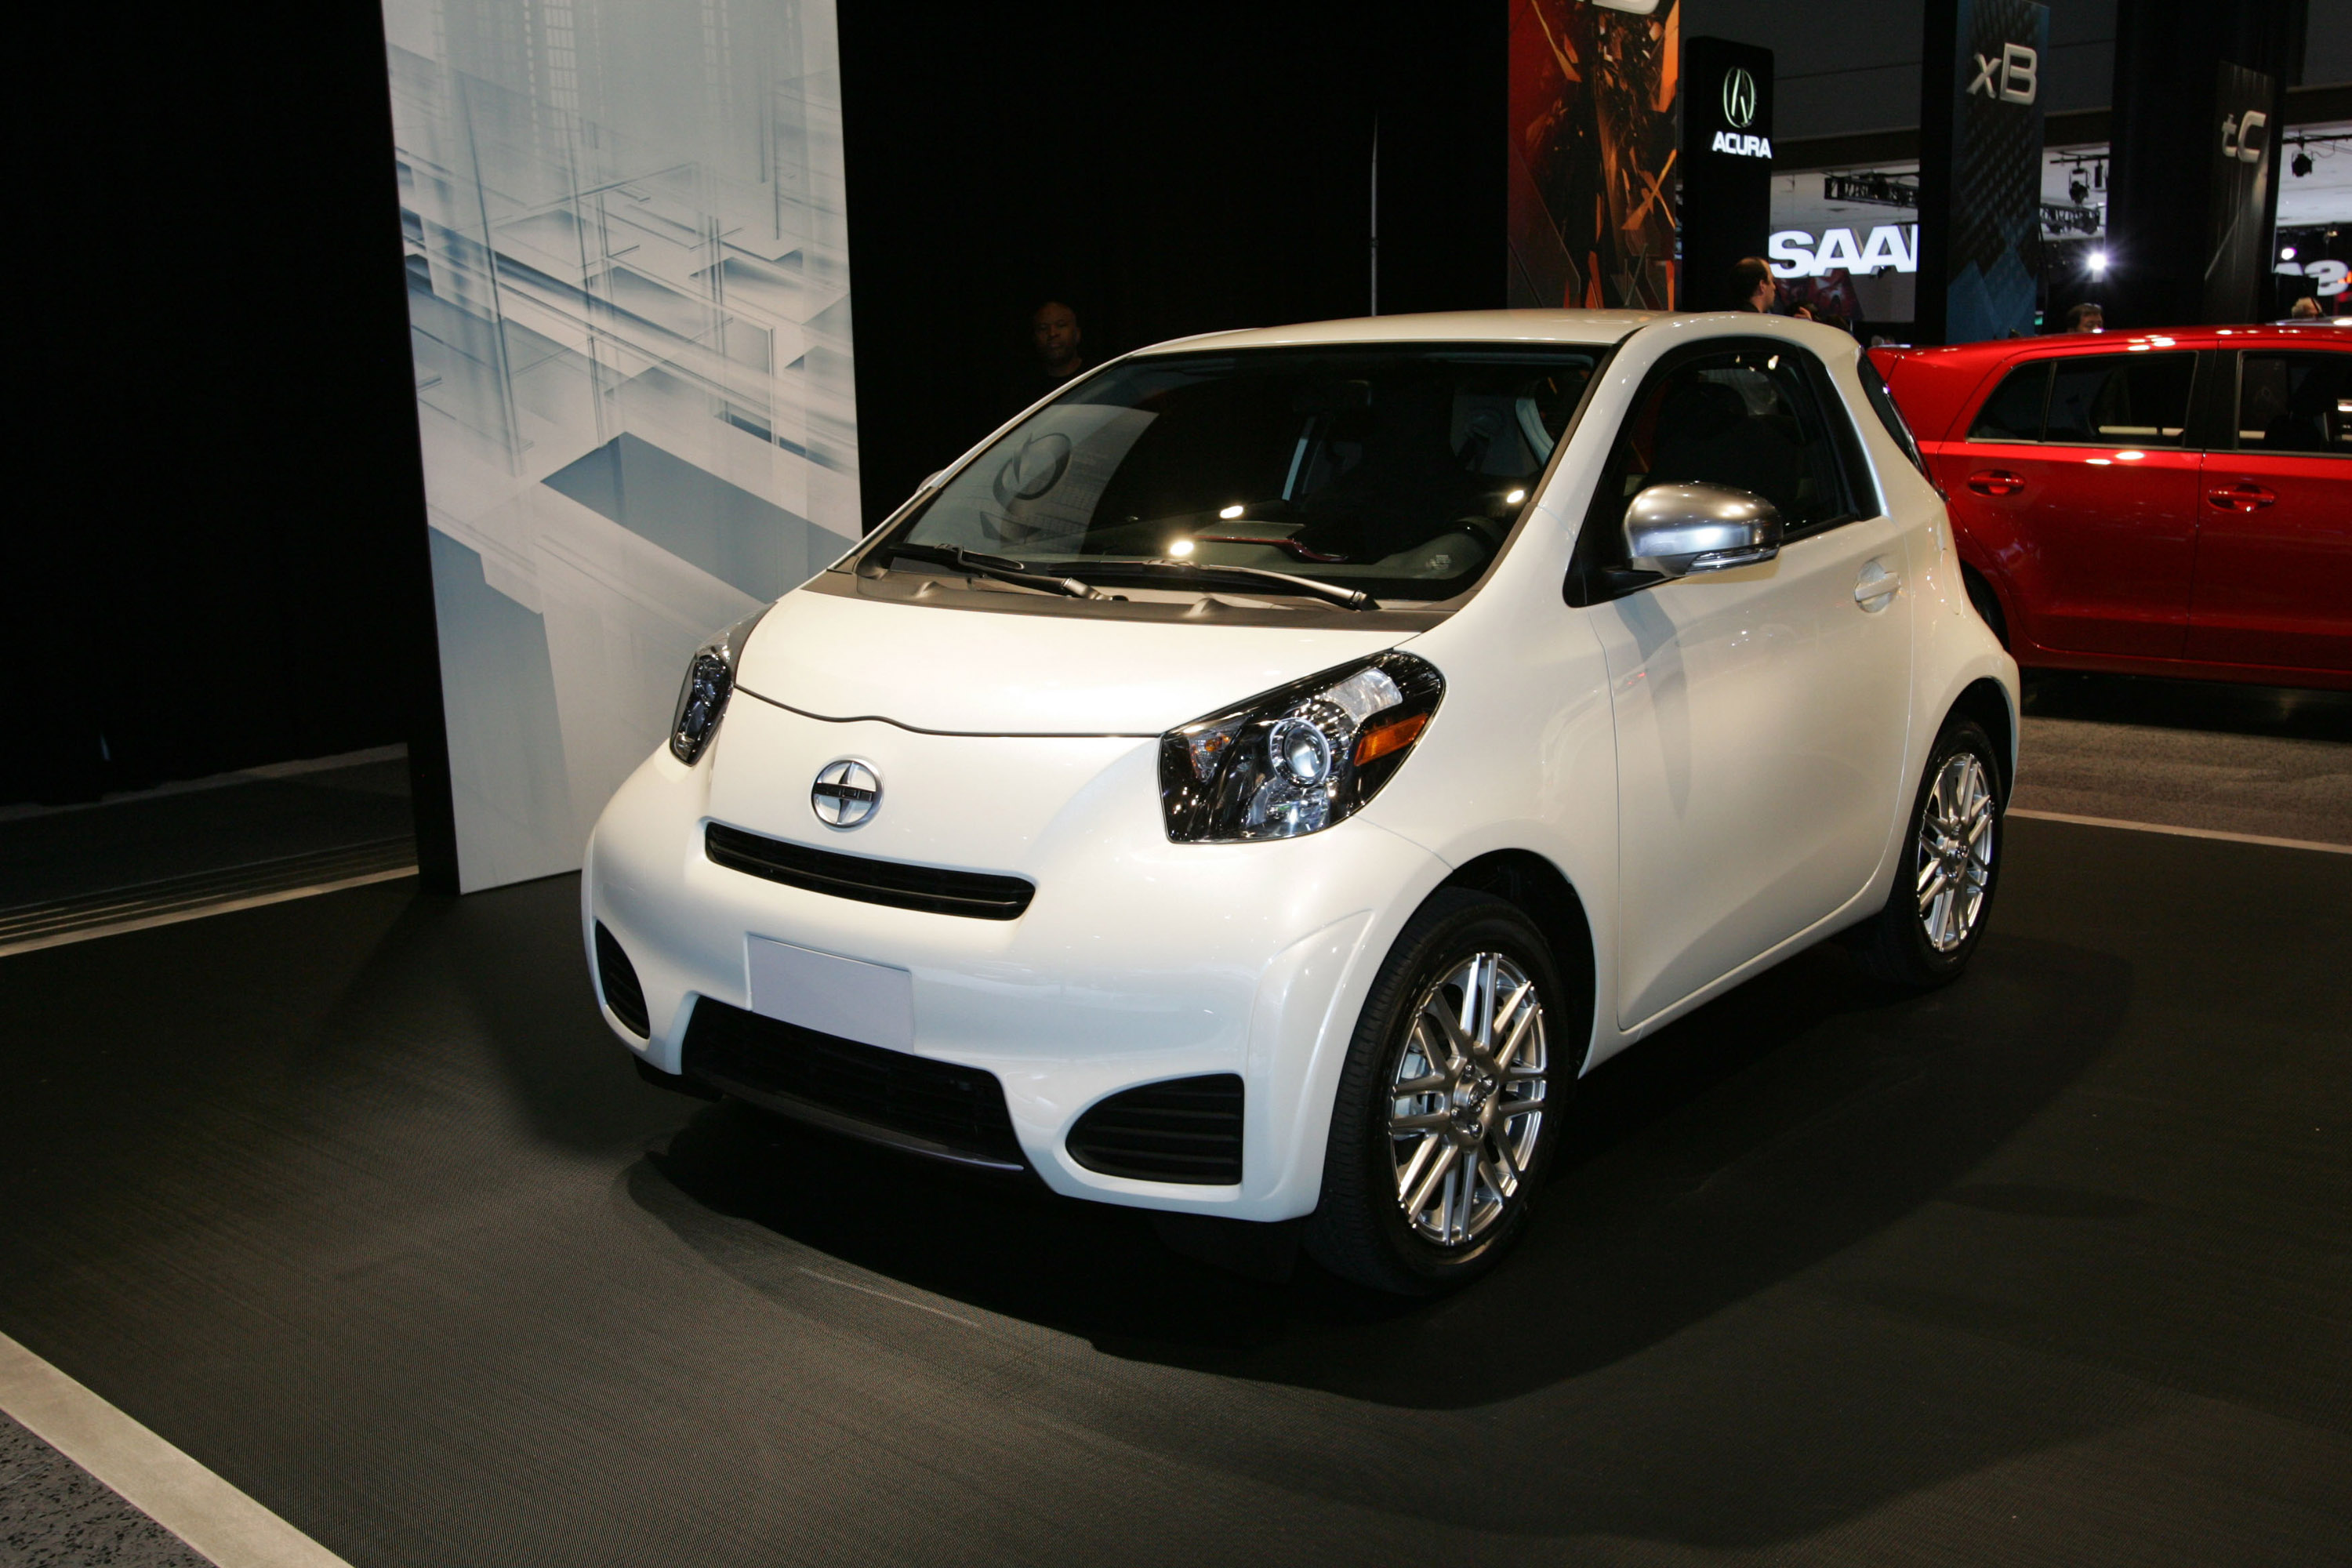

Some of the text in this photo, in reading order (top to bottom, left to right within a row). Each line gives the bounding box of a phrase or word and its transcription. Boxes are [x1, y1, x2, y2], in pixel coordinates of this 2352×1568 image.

[1966, 42, 2038, 105] xB
[1711, 130, 1773, 159] ACURA
[2221, 110, 2267, 163] tC
[1768, 223, 1918, 279] SAA
